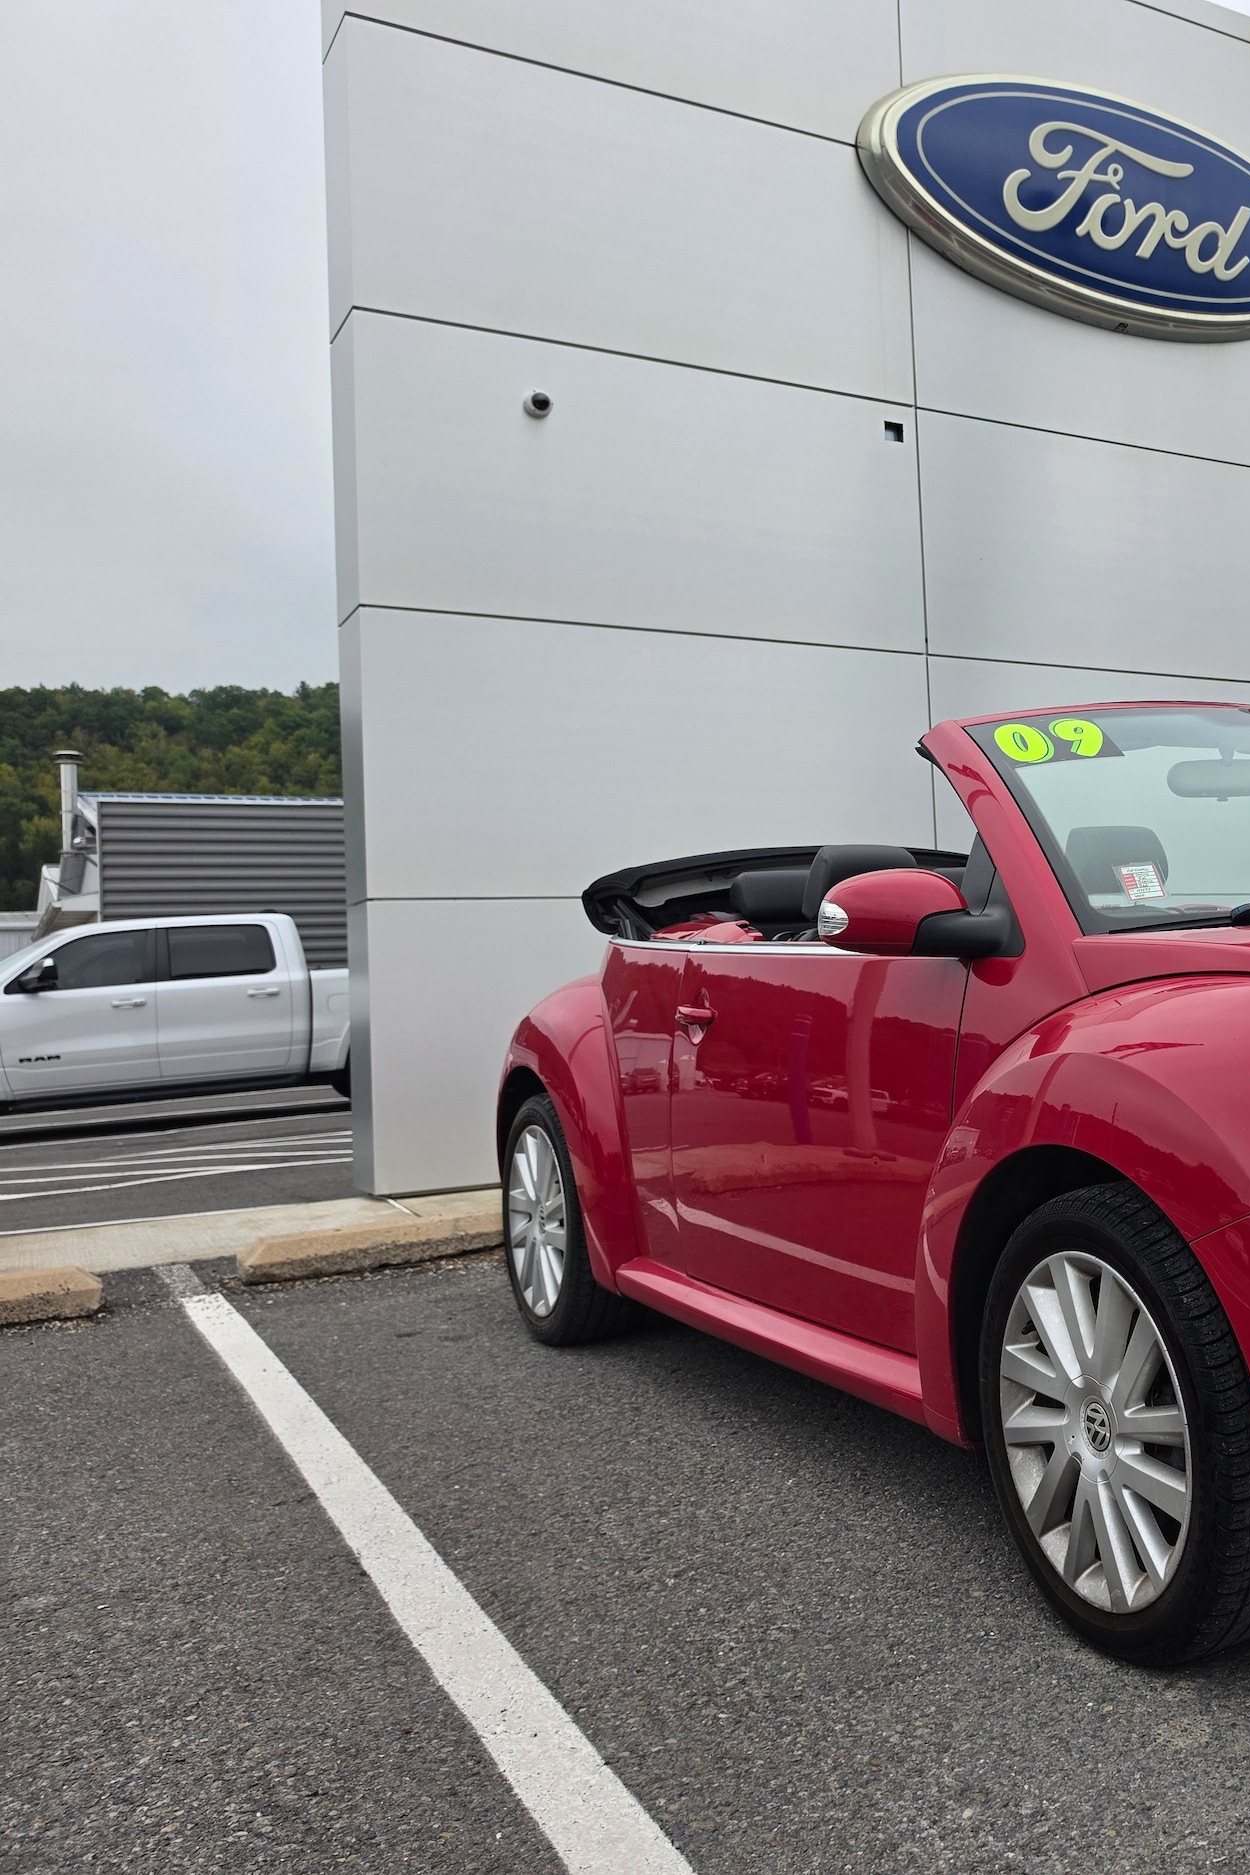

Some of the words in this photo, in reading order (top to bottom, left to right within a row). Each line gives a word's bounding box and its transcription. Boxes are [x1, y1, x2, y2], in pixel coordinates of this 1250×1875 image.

[1003, 121, 1250, 282] Ford
[994, 718, 1103, 763] 09
[19, 1055, 61, 1063] RAM
